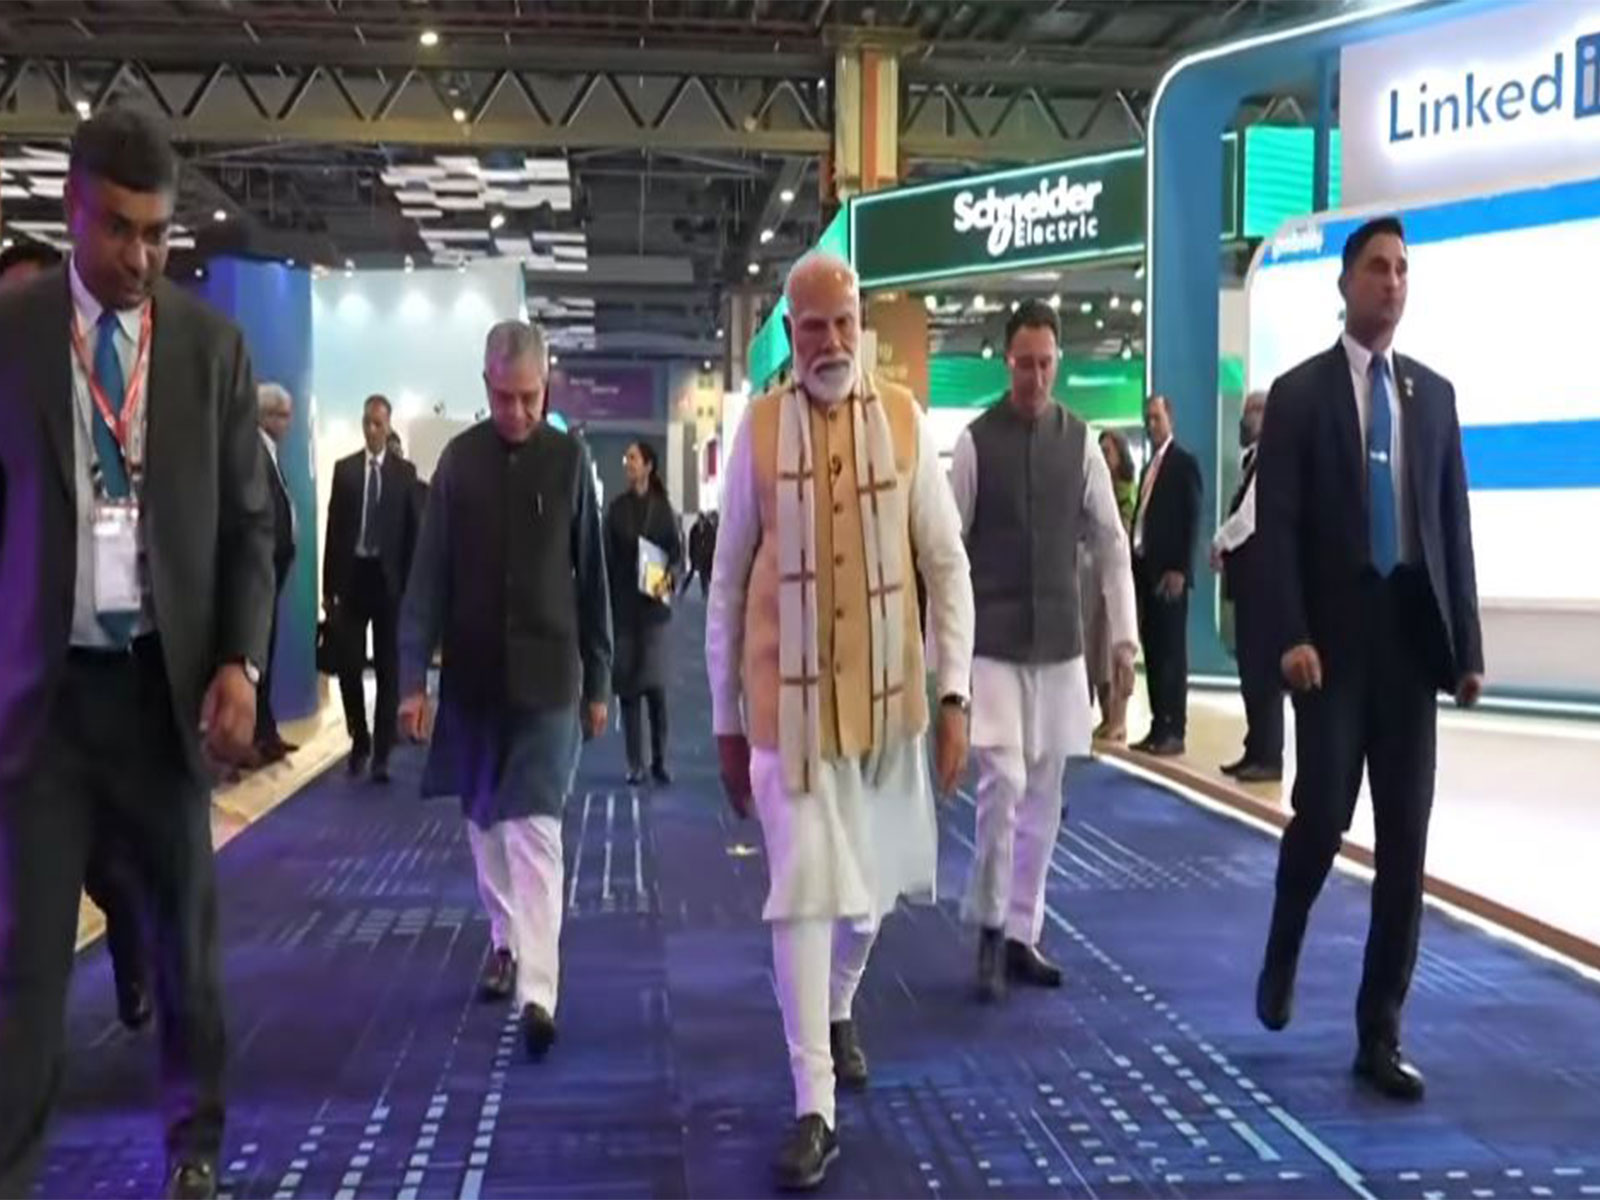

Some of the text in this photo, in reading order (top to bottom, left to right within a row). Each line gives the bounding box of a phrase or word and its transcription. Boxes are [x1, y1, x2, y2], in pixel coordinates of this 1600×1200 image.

[1389, 40, 1600, 144] Linkedi
[953, 175, 1103, 257] Schneider
[1014, 213, 1098, 248] Electric
